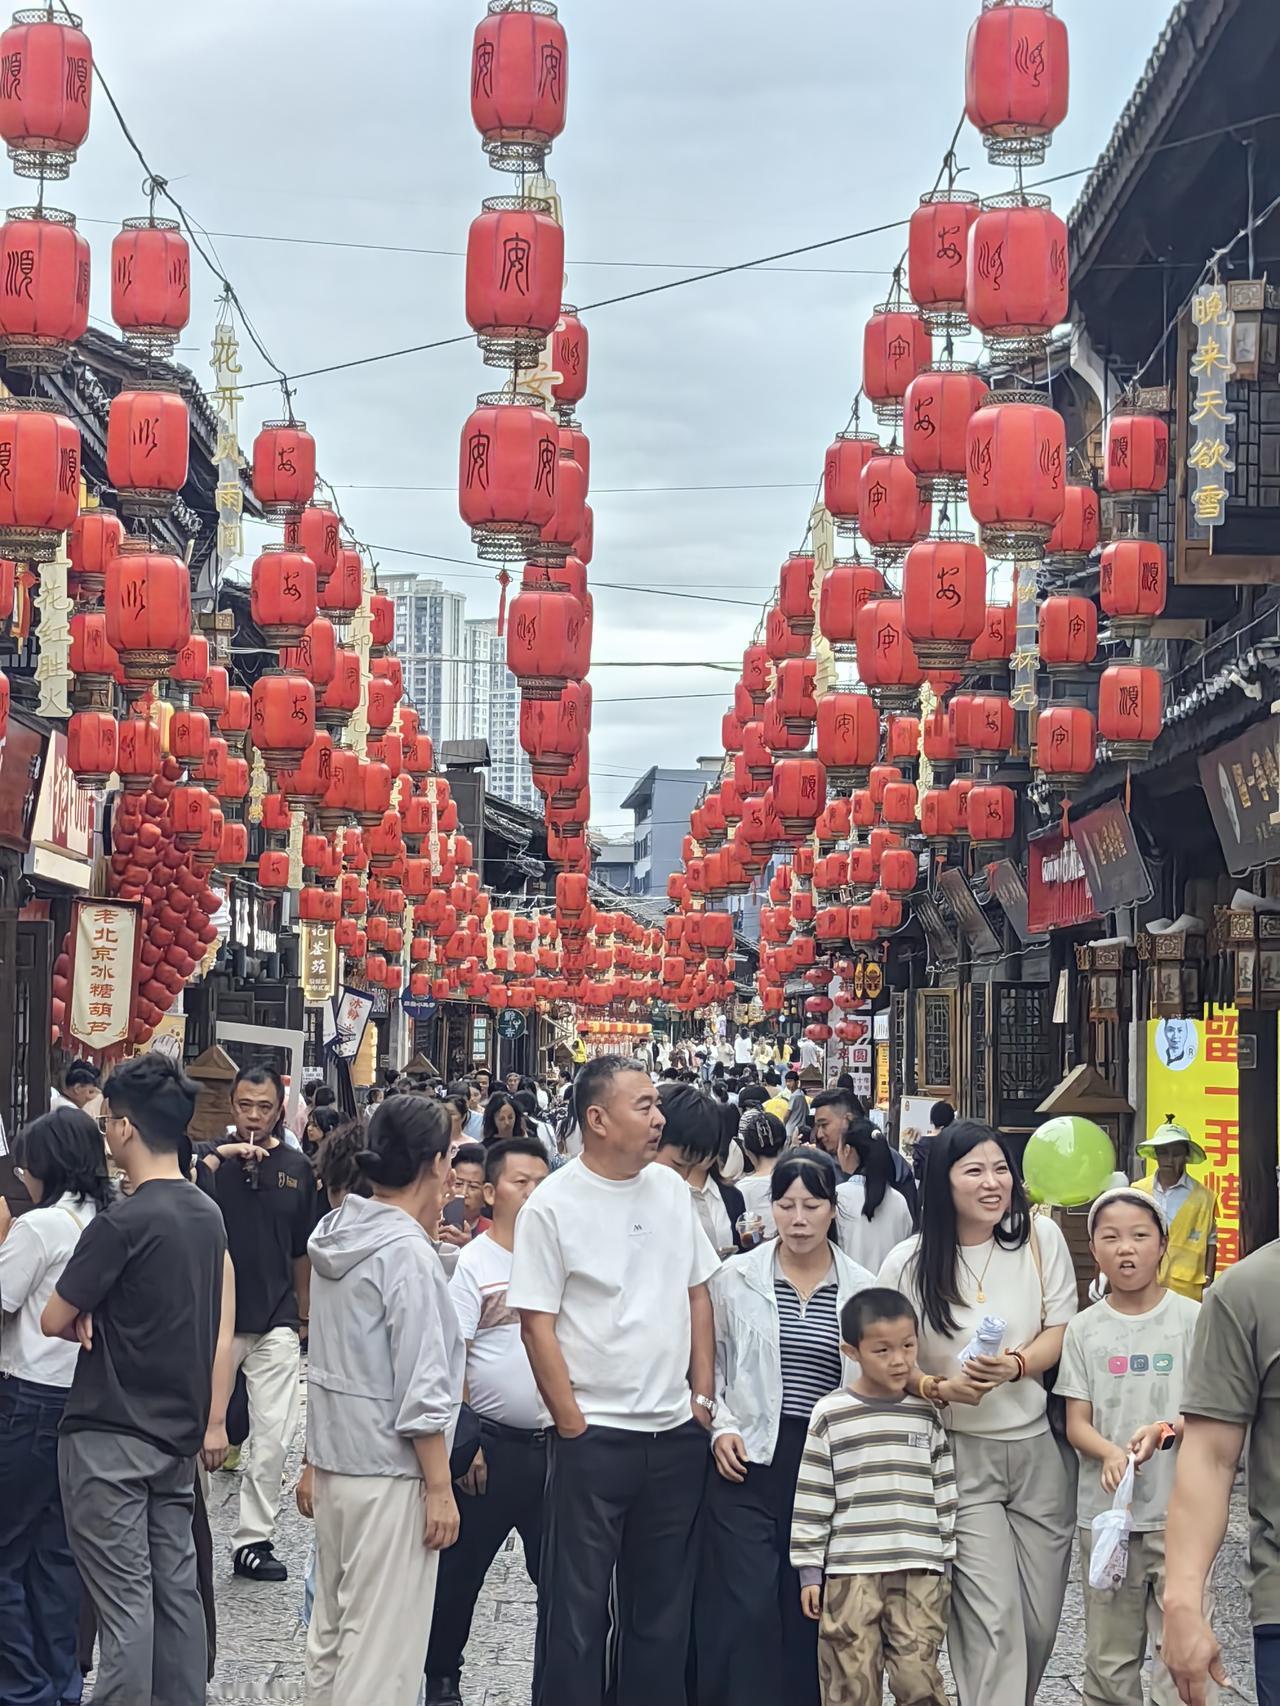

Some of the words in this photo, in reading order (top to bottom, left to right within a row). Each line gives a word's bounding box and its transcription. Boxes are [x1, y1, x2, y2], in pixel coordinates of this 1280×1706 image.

[1190, 290, 1234, 519] 晚来天欲雪
[37, 555, 72, 715] 花红胜火
[88, 908, 120, 1034] 老北京冰糖葫芦
